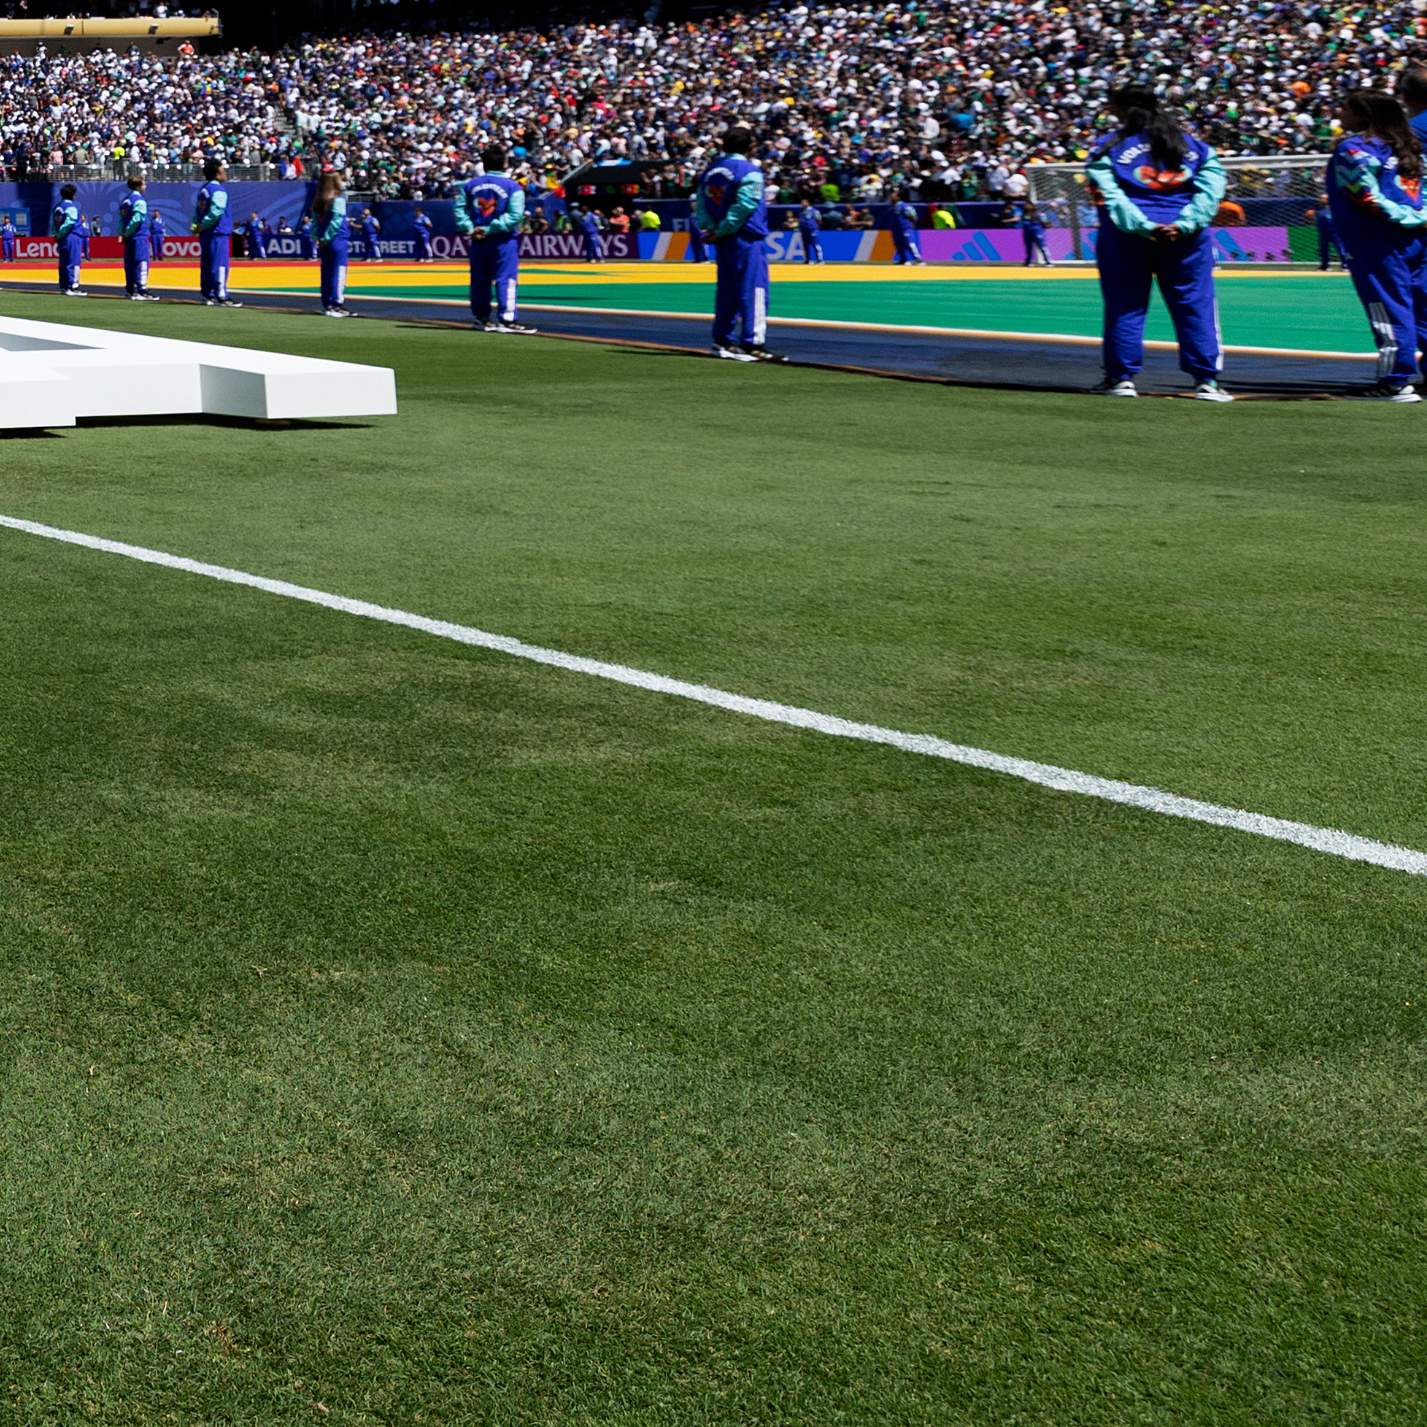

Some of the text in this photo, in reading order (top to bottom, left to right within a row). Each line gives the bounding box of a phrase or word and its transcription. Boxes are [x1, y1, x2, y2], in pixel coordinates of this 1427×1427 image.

[266, 239, 301, 254] ADI
[518, 234, 629, 257] AIRWYS
[765, 231, 806, 261] SA
